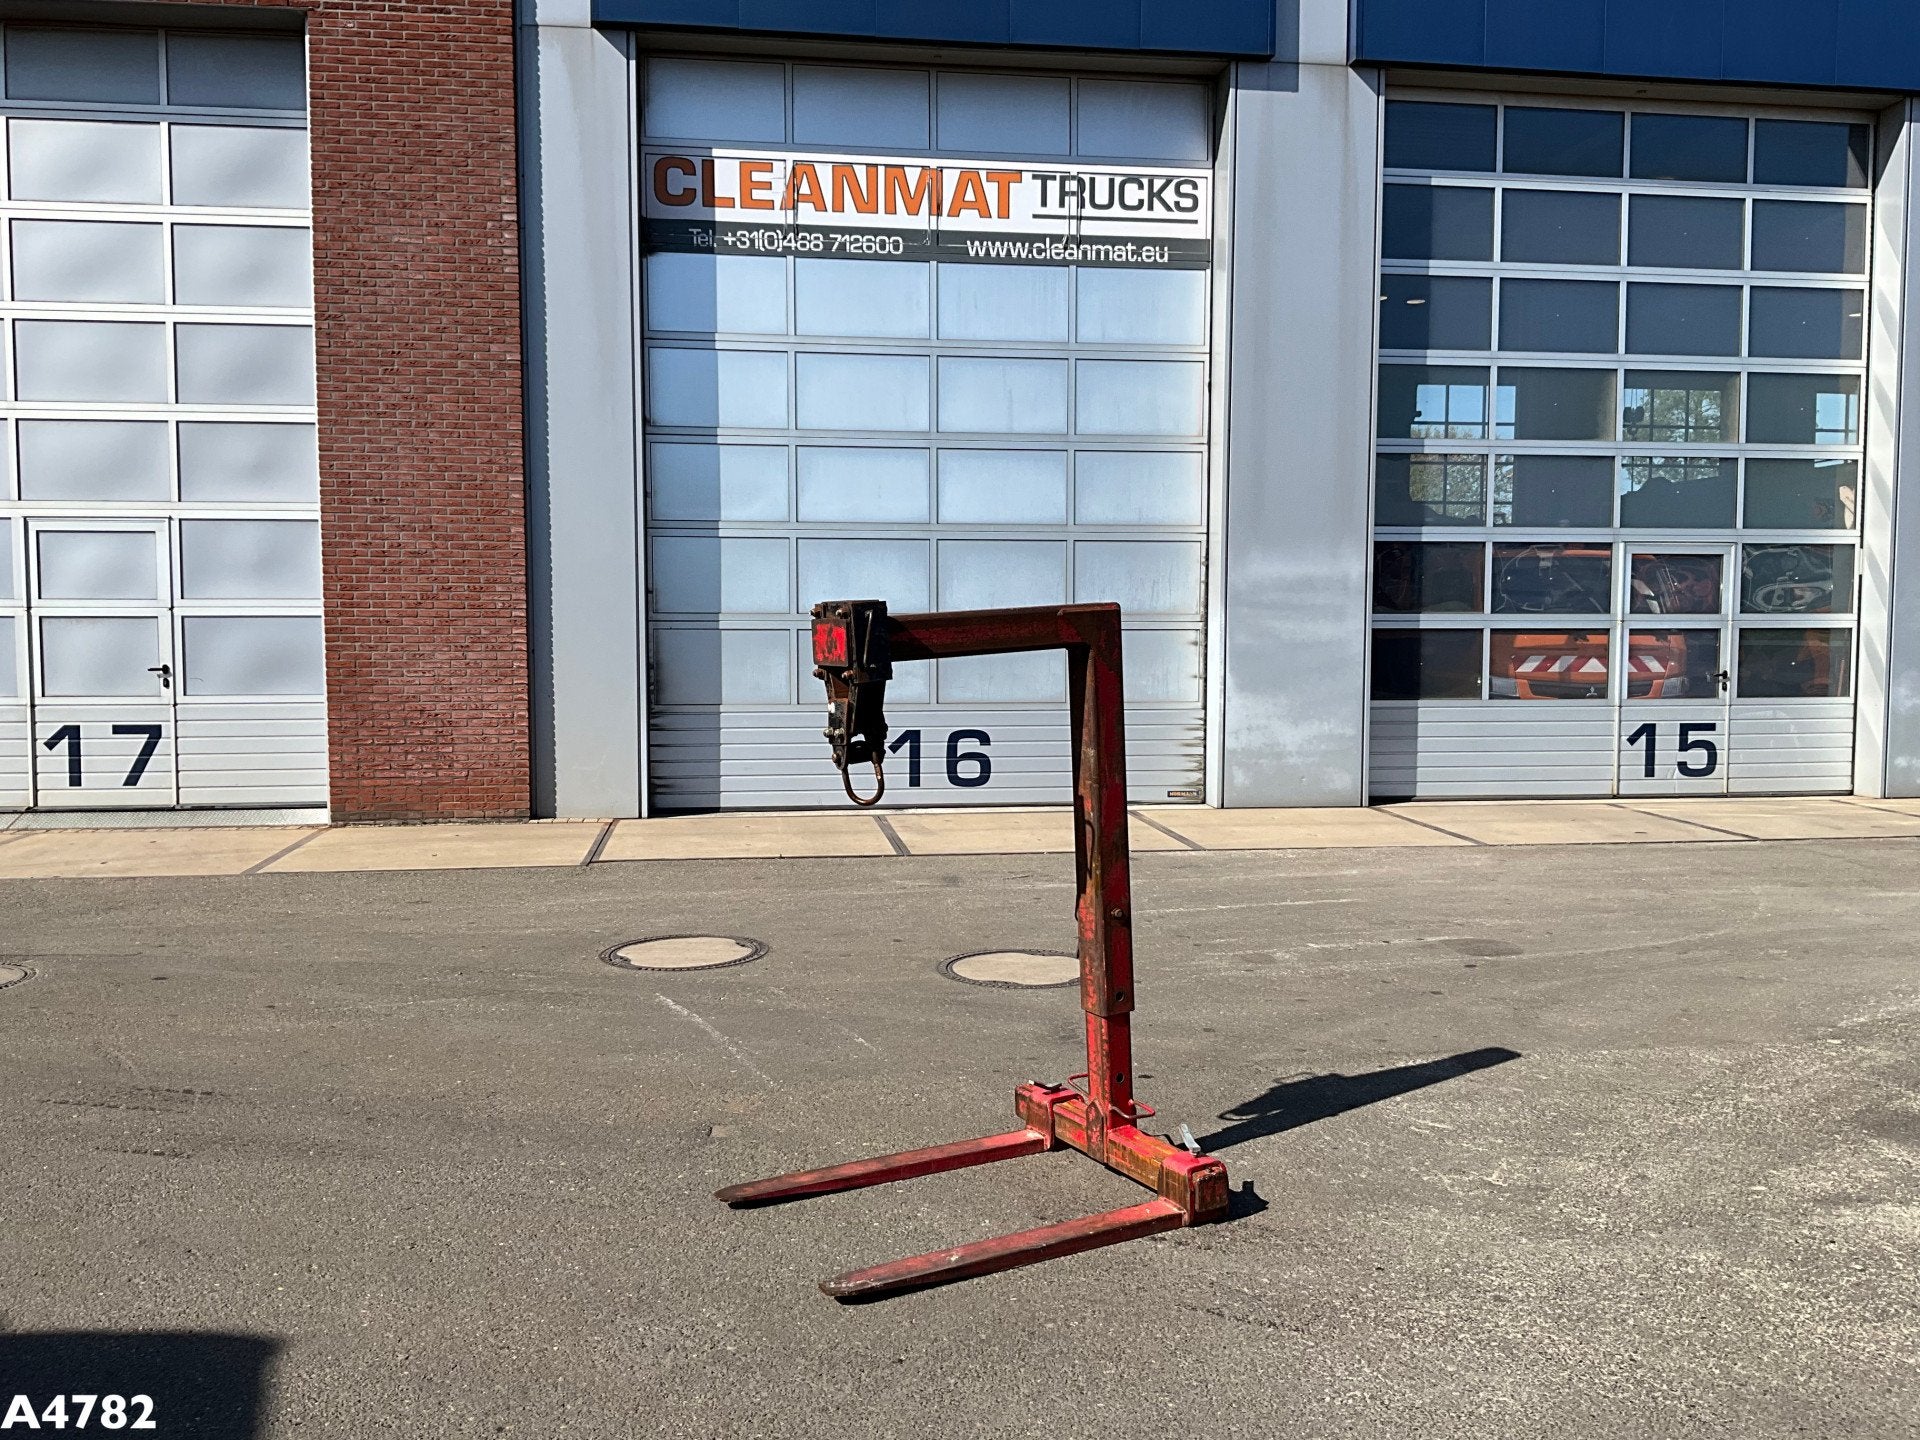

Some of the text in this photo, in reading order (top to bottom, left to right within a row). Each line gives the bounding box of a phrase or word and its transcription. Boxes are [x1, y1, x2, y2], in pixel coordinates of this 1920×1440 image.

[653, 156, 1199, 219] CLEANMAT TRUCKS
[688, 227, 717, 248] Tel.
[830, 233, 904, 255] 712600
[966, 237, 1169, 263] www.cleanmat.eu
[42, 724, 163, 787] 17
[887, 729, 992, 788] 16
[1626, 722, 1718, 778] 15
